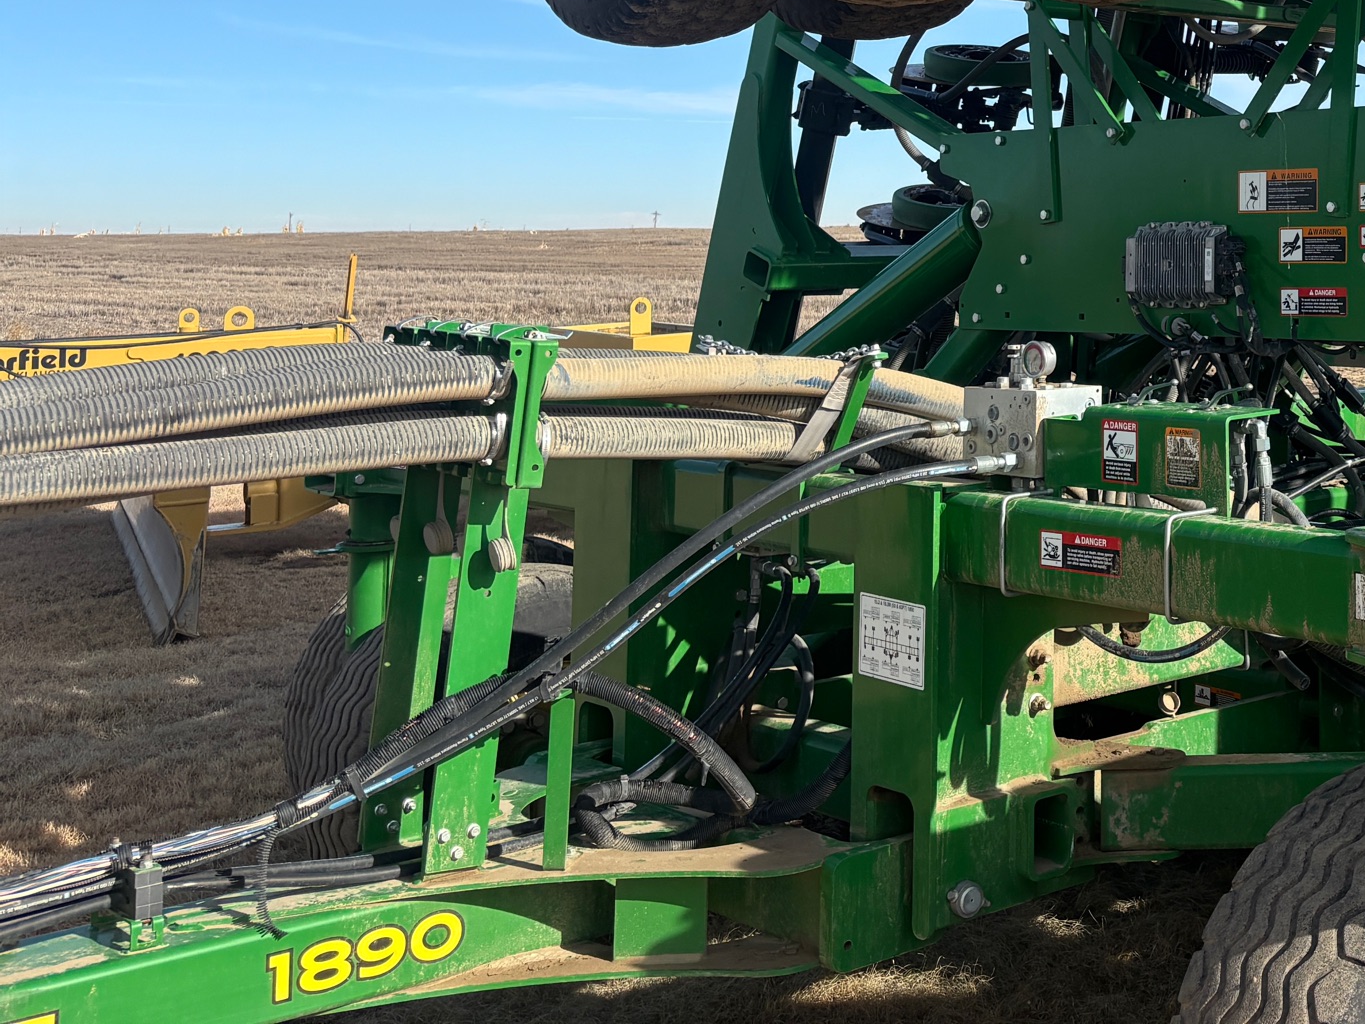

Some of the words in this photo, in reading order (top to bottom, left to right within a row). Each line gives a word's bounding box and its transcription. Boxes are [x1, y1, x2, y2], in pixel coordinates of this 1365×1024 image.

[1109, 421, 1137, 431] DANGER
[1081, 536, 1107, 547] DANGER
[267, 911, 464, 1004] 1890
